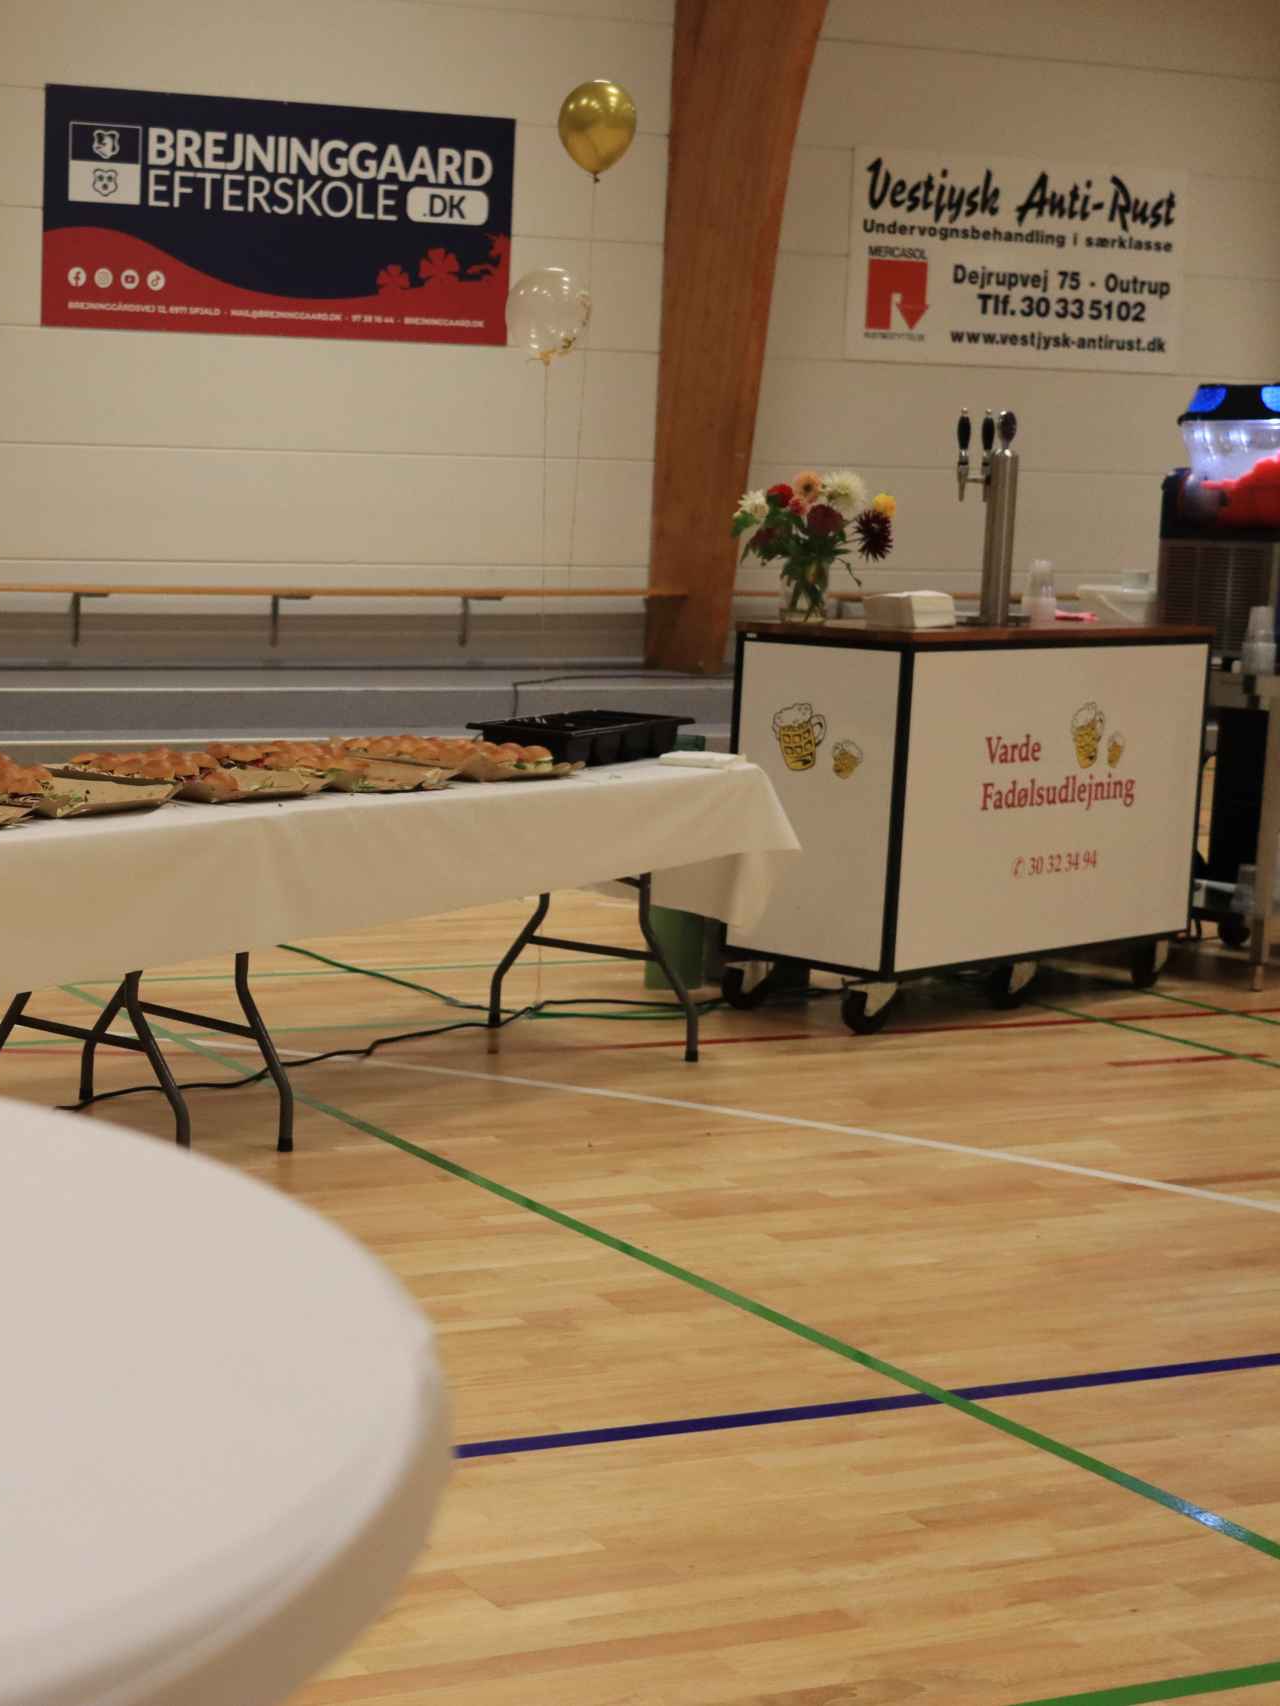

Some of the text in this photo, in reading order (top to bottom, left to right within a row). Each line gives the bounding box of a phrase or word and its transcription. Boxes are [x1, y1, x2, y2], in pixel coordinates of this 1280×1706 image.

[148, 127, 493, 186] BREJNINGGAARD
[148, 170, 398, 221] EFTERSKOLE
[866, 157, 1176, 232] Vestjysk Anti-Rust
[863, 219, 1173, 252] Undervognsbehandling i særklasse
[953, 264, 1047, 291] Dejrupvej
[1058, 271, 1080, 290] 75
[1105, 274, 1170, 298] Outrup
[978, 294, 1015, 316] Tlf.
[951, 330, 1166, 353] www.vestjysk-antirust.dk
[985, 734, 1042, 766] Varde
[981, 774, 1136, 812] Fadølsudlejning
[1028, 851, 1097, 876] 30 32 34 94
